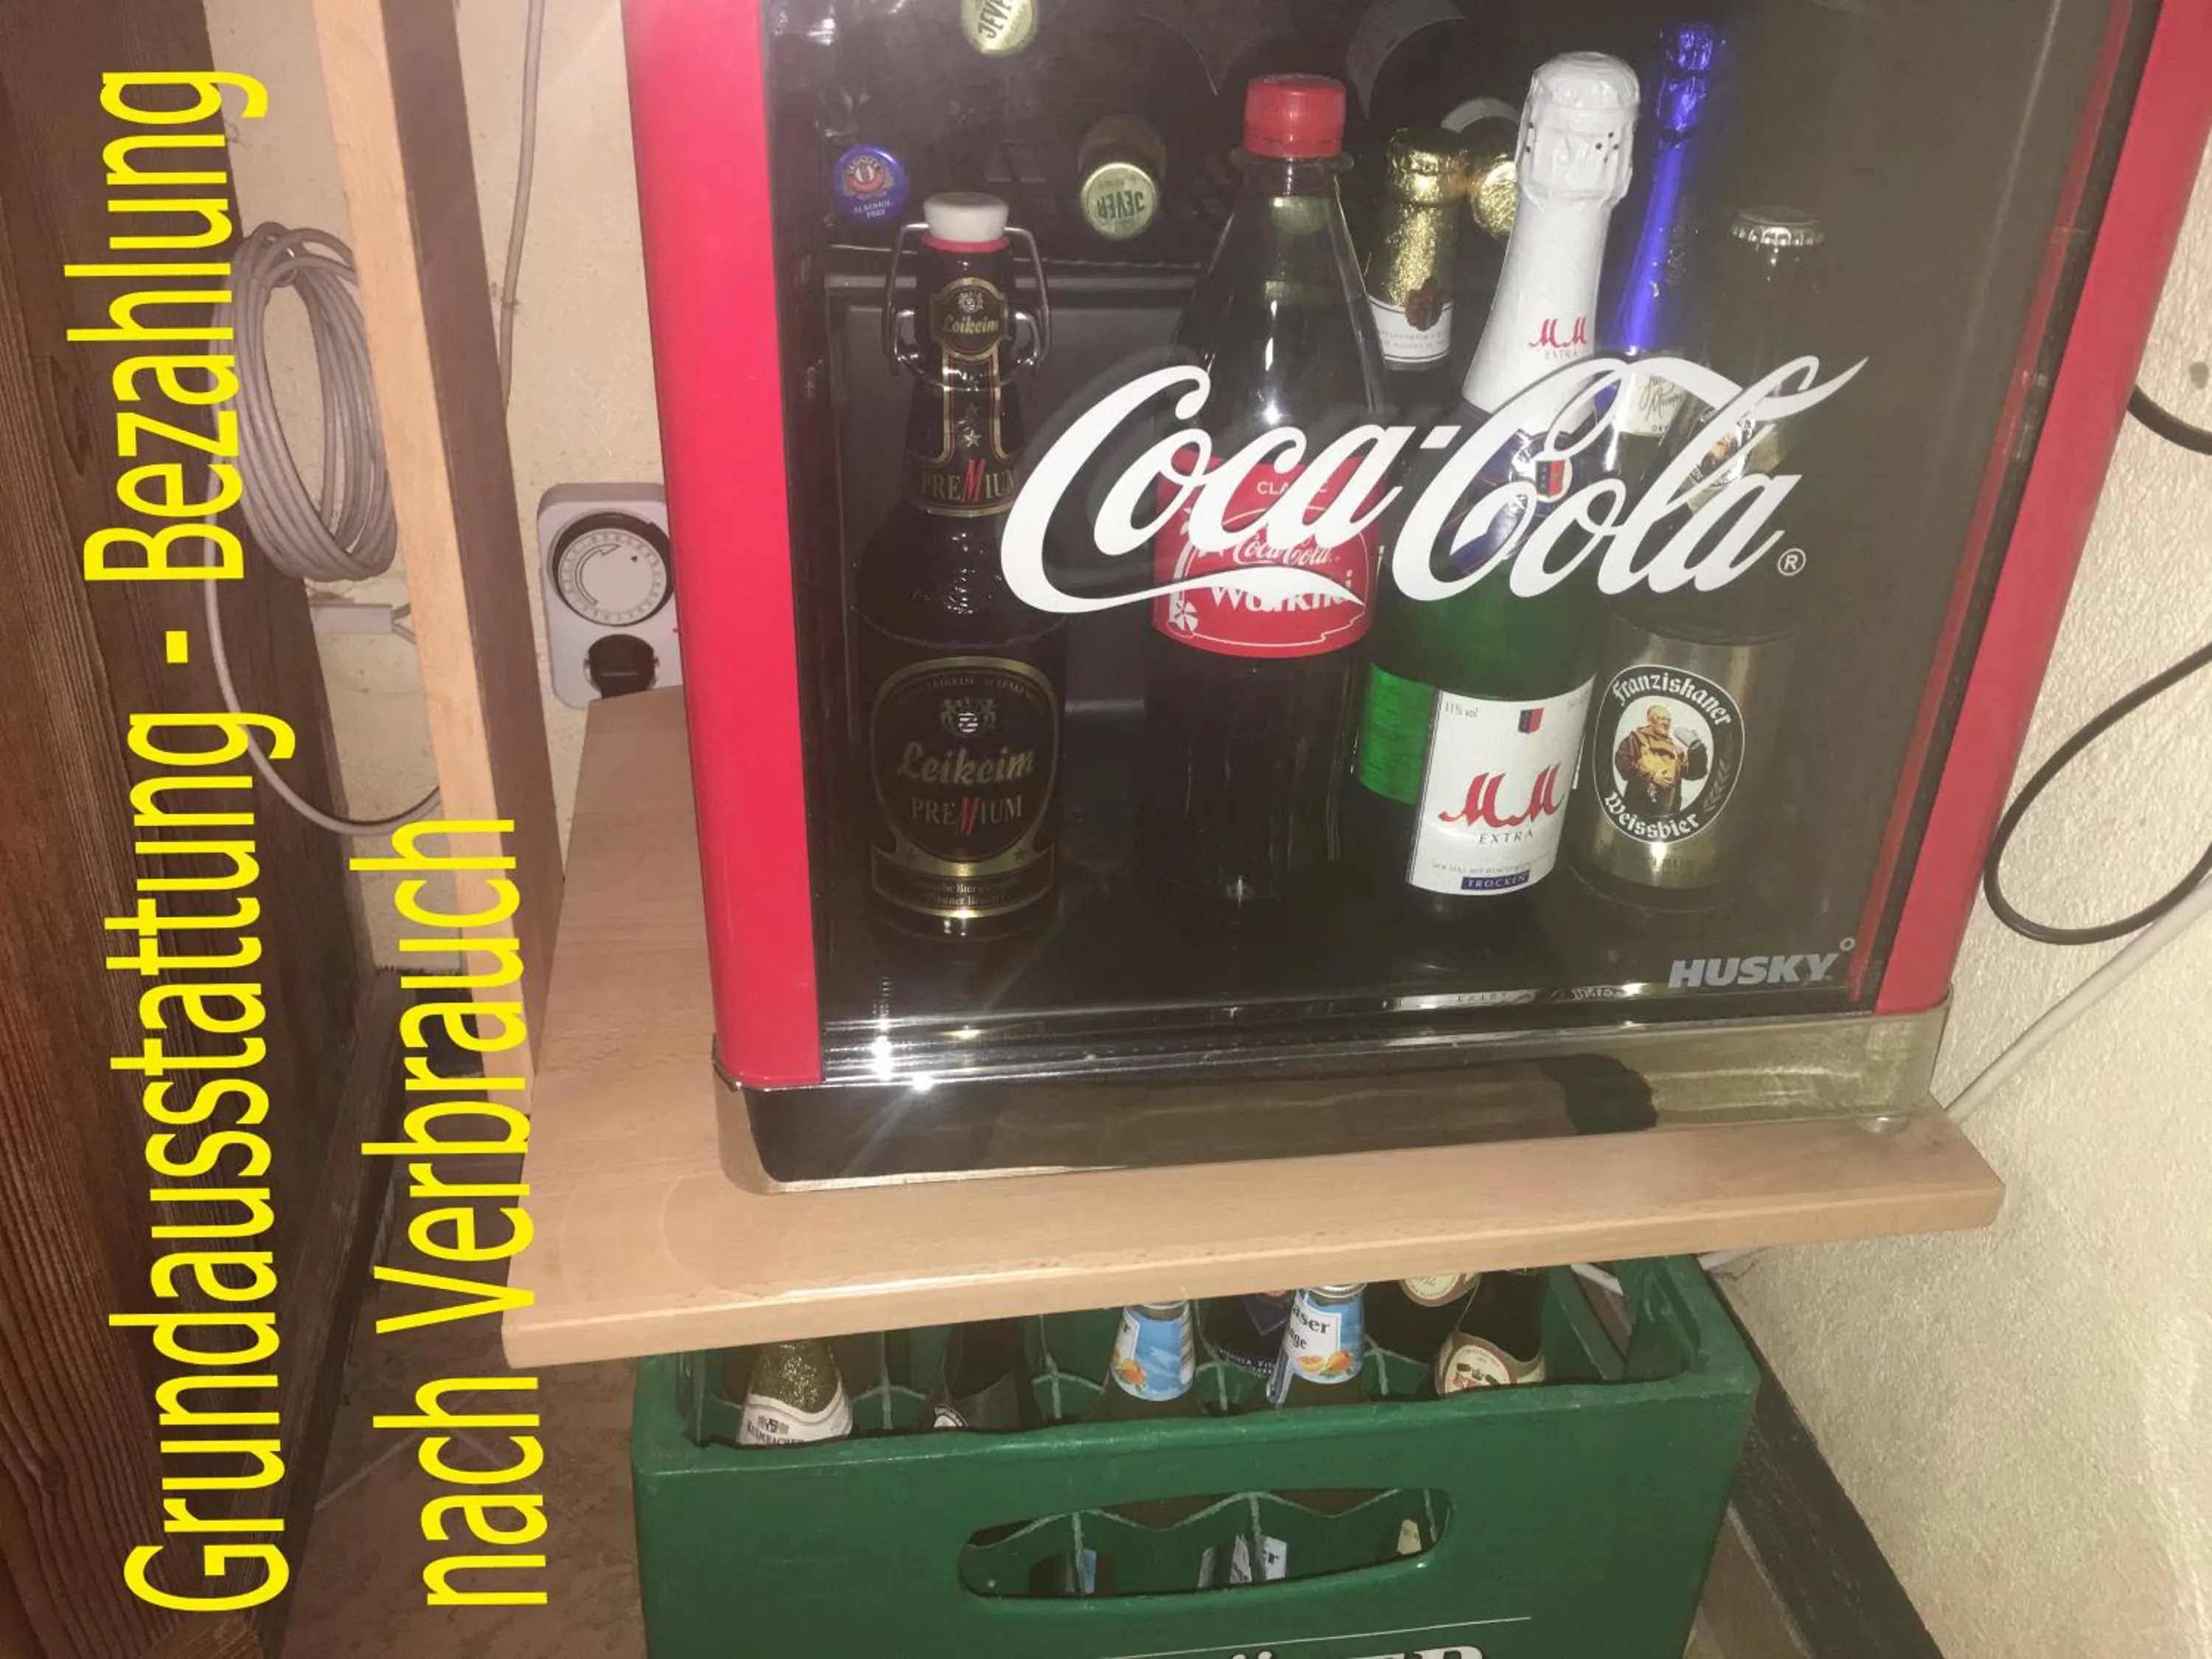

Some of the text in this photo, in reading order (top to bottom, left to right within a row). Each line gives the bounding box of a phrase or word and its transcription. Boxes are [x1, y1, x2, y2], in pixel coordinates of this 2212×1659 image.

[1096, 189, 1145, 220] JEVER
[1001, 357, 1868, 613] Coca-Cola
[1232, 531, 1333, 566] CocaCola
[1612, 672, 1731, 726] Franziskaner
[897, 740, 1036, 785] Leikeim
[911, 794, 1023, 837] PREMIUM
[1604, 790, 1700, 839] Weissbier
[1478, 829, 1534, 845] EXTRA
[1465, 873, 1526, 888] TROCKEN
[1668, 953, 1839, 989] HUSKY
